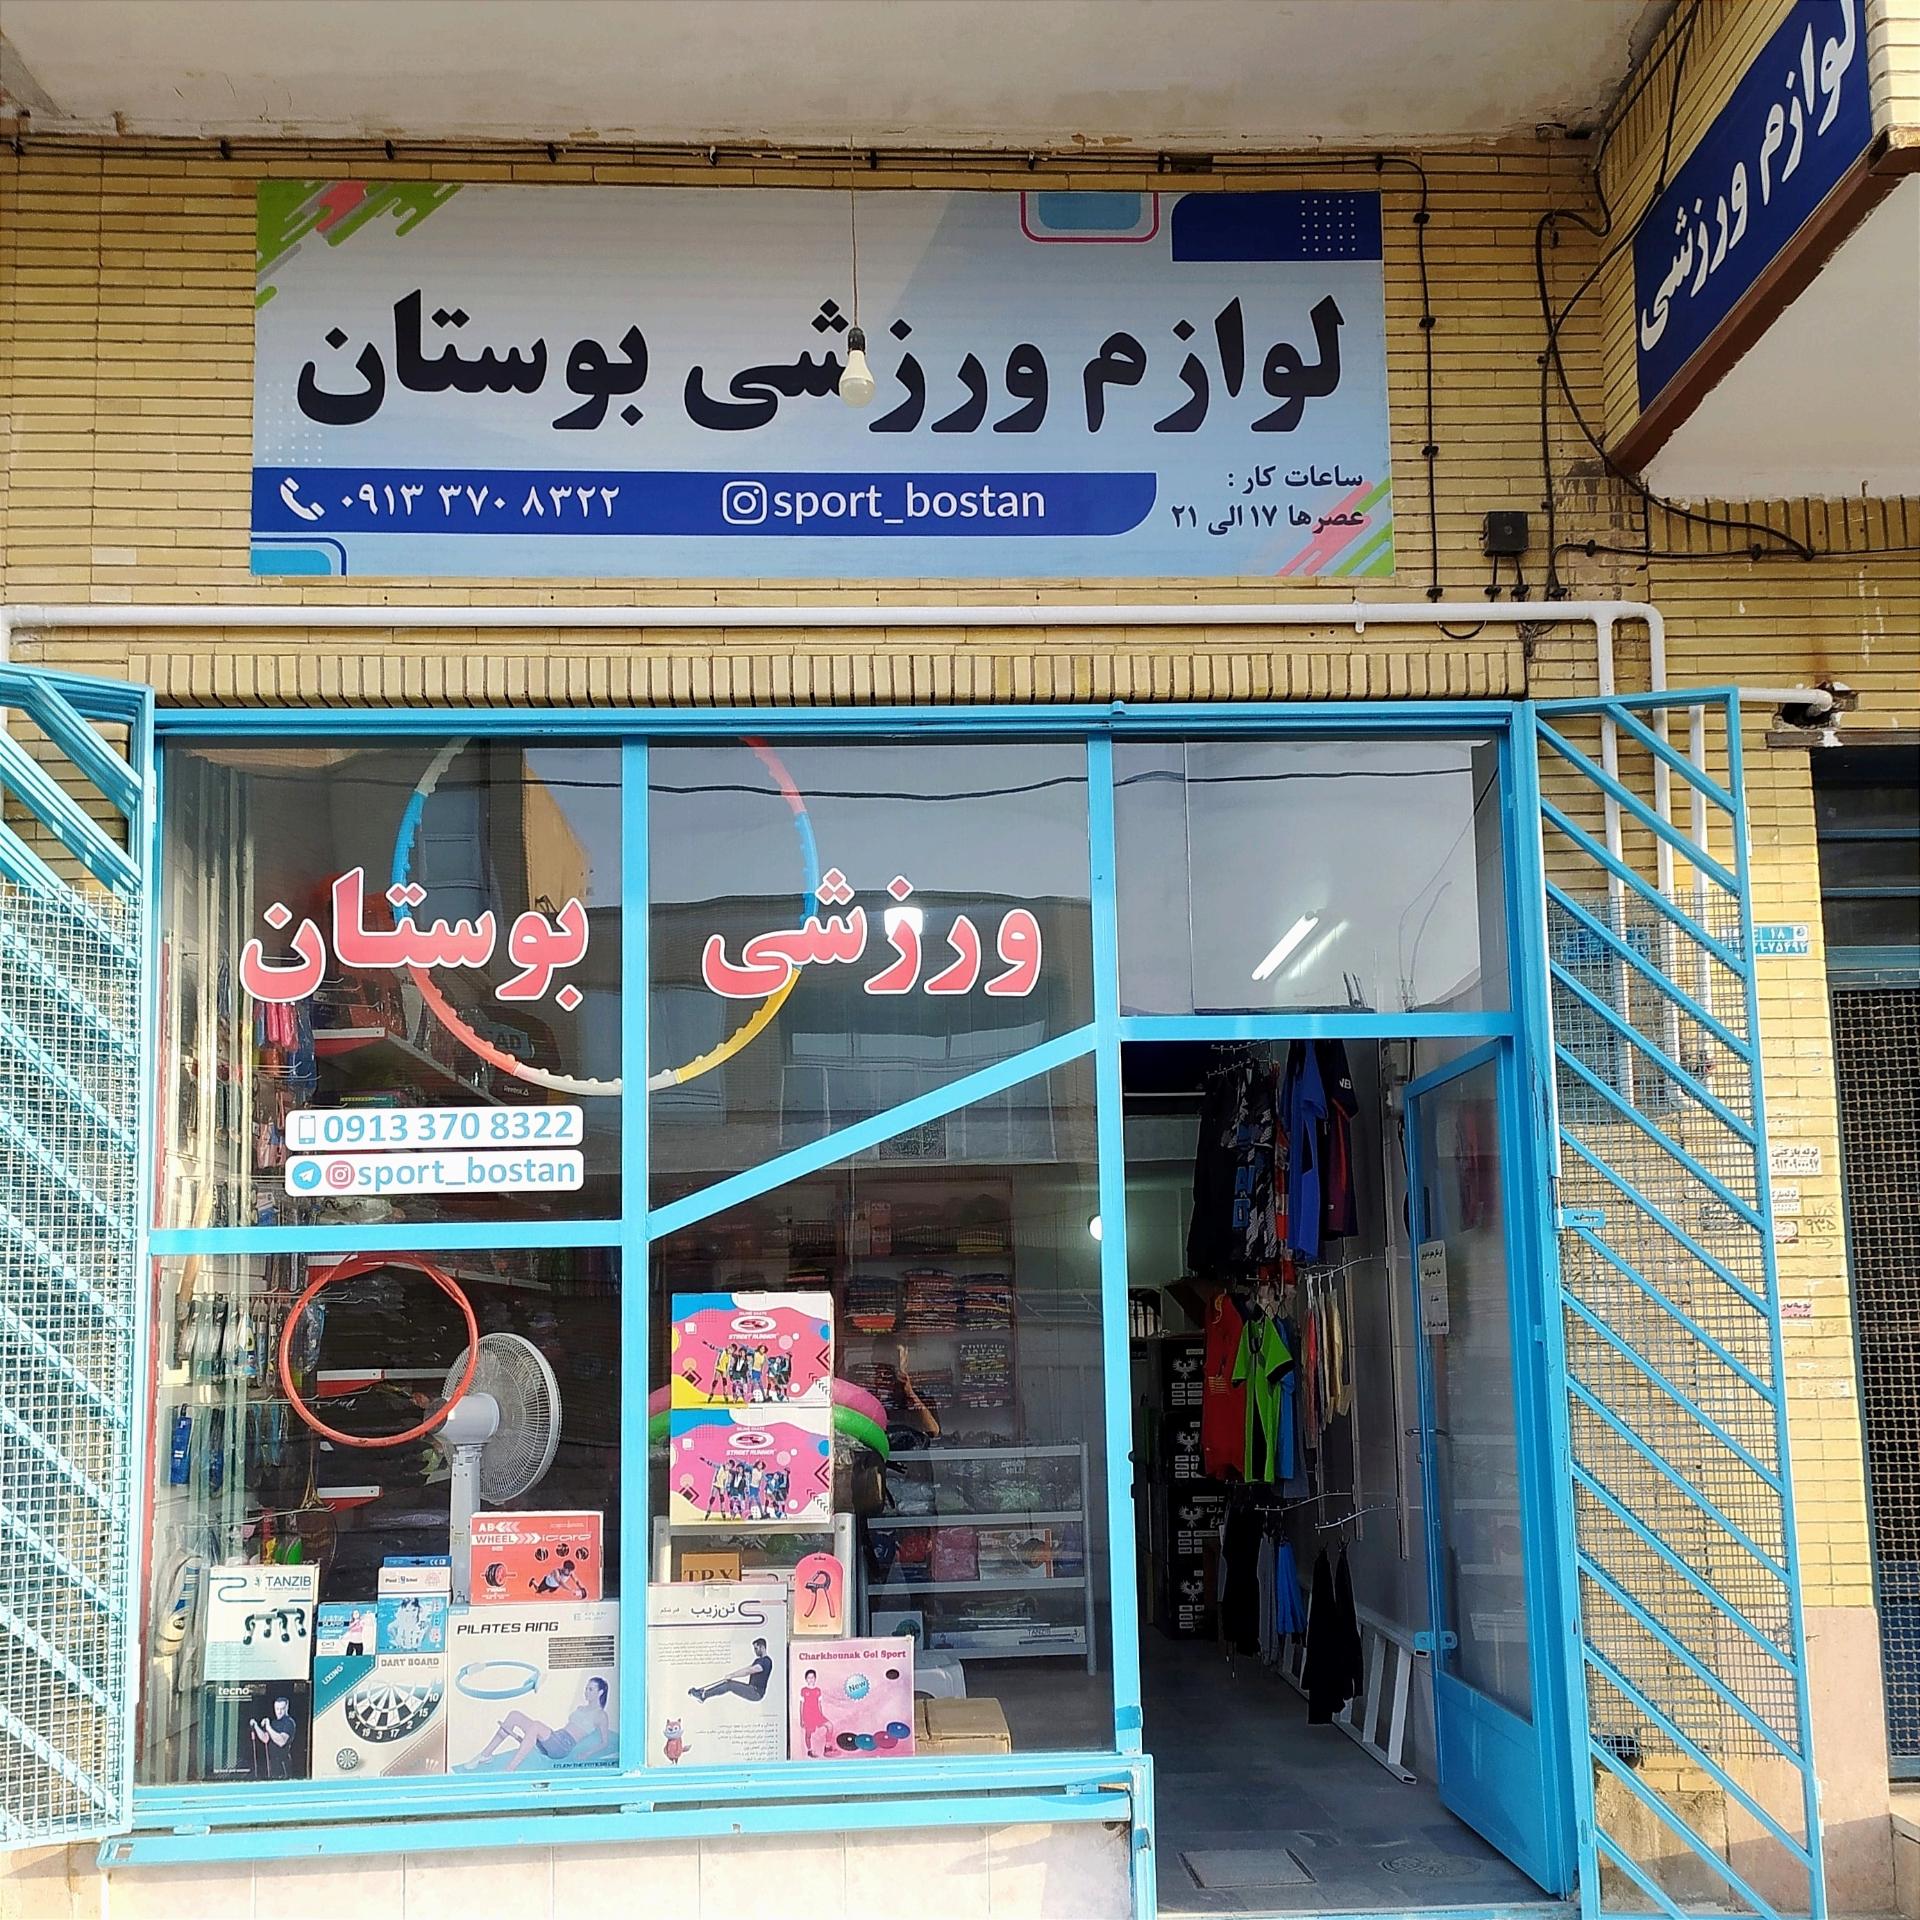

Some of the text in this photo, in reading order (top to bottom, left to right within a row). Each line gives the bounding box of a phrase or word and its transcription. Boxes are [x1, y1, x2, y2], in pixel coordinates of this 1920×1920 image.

[1640, 0, 1857, 352] لوازم ورزشی
[296, 288, 1346, 433] لوازم ورزشی بوستان
[1241, 464, 1277, 493] کار
[1285, 465, 1364, 488] ساعات
[340, 484, 621, 520] ۰۹۱۳ ۳۷۰ ۸۳۲۲
[773, 482, 1046, 526] sport_bostan
[1169, 504, 1199, 529] ۲۱
[1286, 505, 1366, 537] عصرها
[240, 866, 1042, 1011] ورزشی بوستان
[323, 1110, 575, 1143] 0913 370 8322
[356, 1156, 576, 1191] sport_bostan
[475, 1534, 515, 1544] WHEEL
[478, 1522, 496, 1533] AB
[265, 1575, 312, 1587] TANZIB
[456, 1621, 560, 1635] PILATES RING
[380, 1657, 440, 1668] DART BOARD
[798, 1650, 862, 1661] Charkhounak
[880, 1649, 907, 1662] Sport
[218, 1686, 251, 1696] tecno
